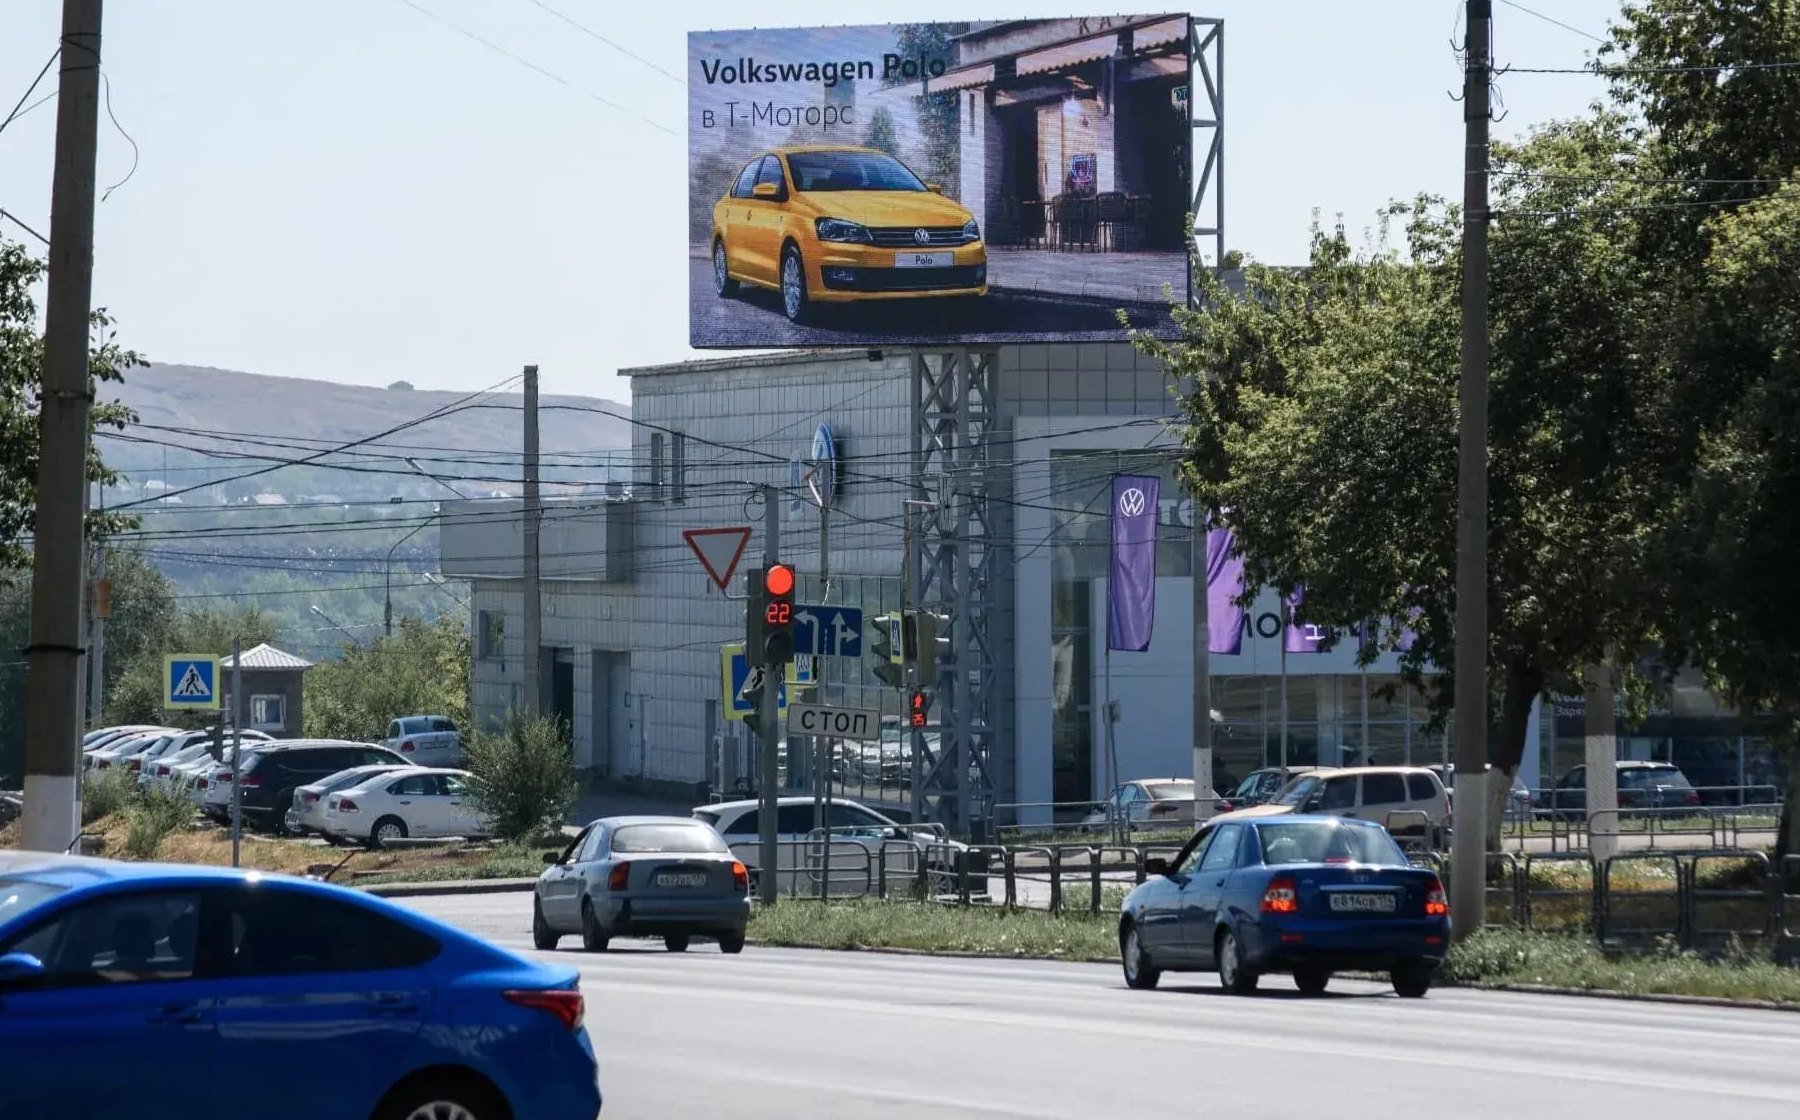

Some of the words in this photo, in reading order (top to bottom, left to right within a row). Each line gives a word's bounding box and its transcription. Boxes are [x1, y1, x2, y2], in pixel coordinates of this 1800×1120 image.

[700, 57, 874, 88] Volkswagen
[883, 53, 947, 80] Polo
[724, 101, 854, 132] Т-Моторс
[915, 254, 933, 265] Polo
[1120, 488, 1145, 517] VW
[767, 604, 790, 623] 22
[801, 710, 868, 735] СТОП
